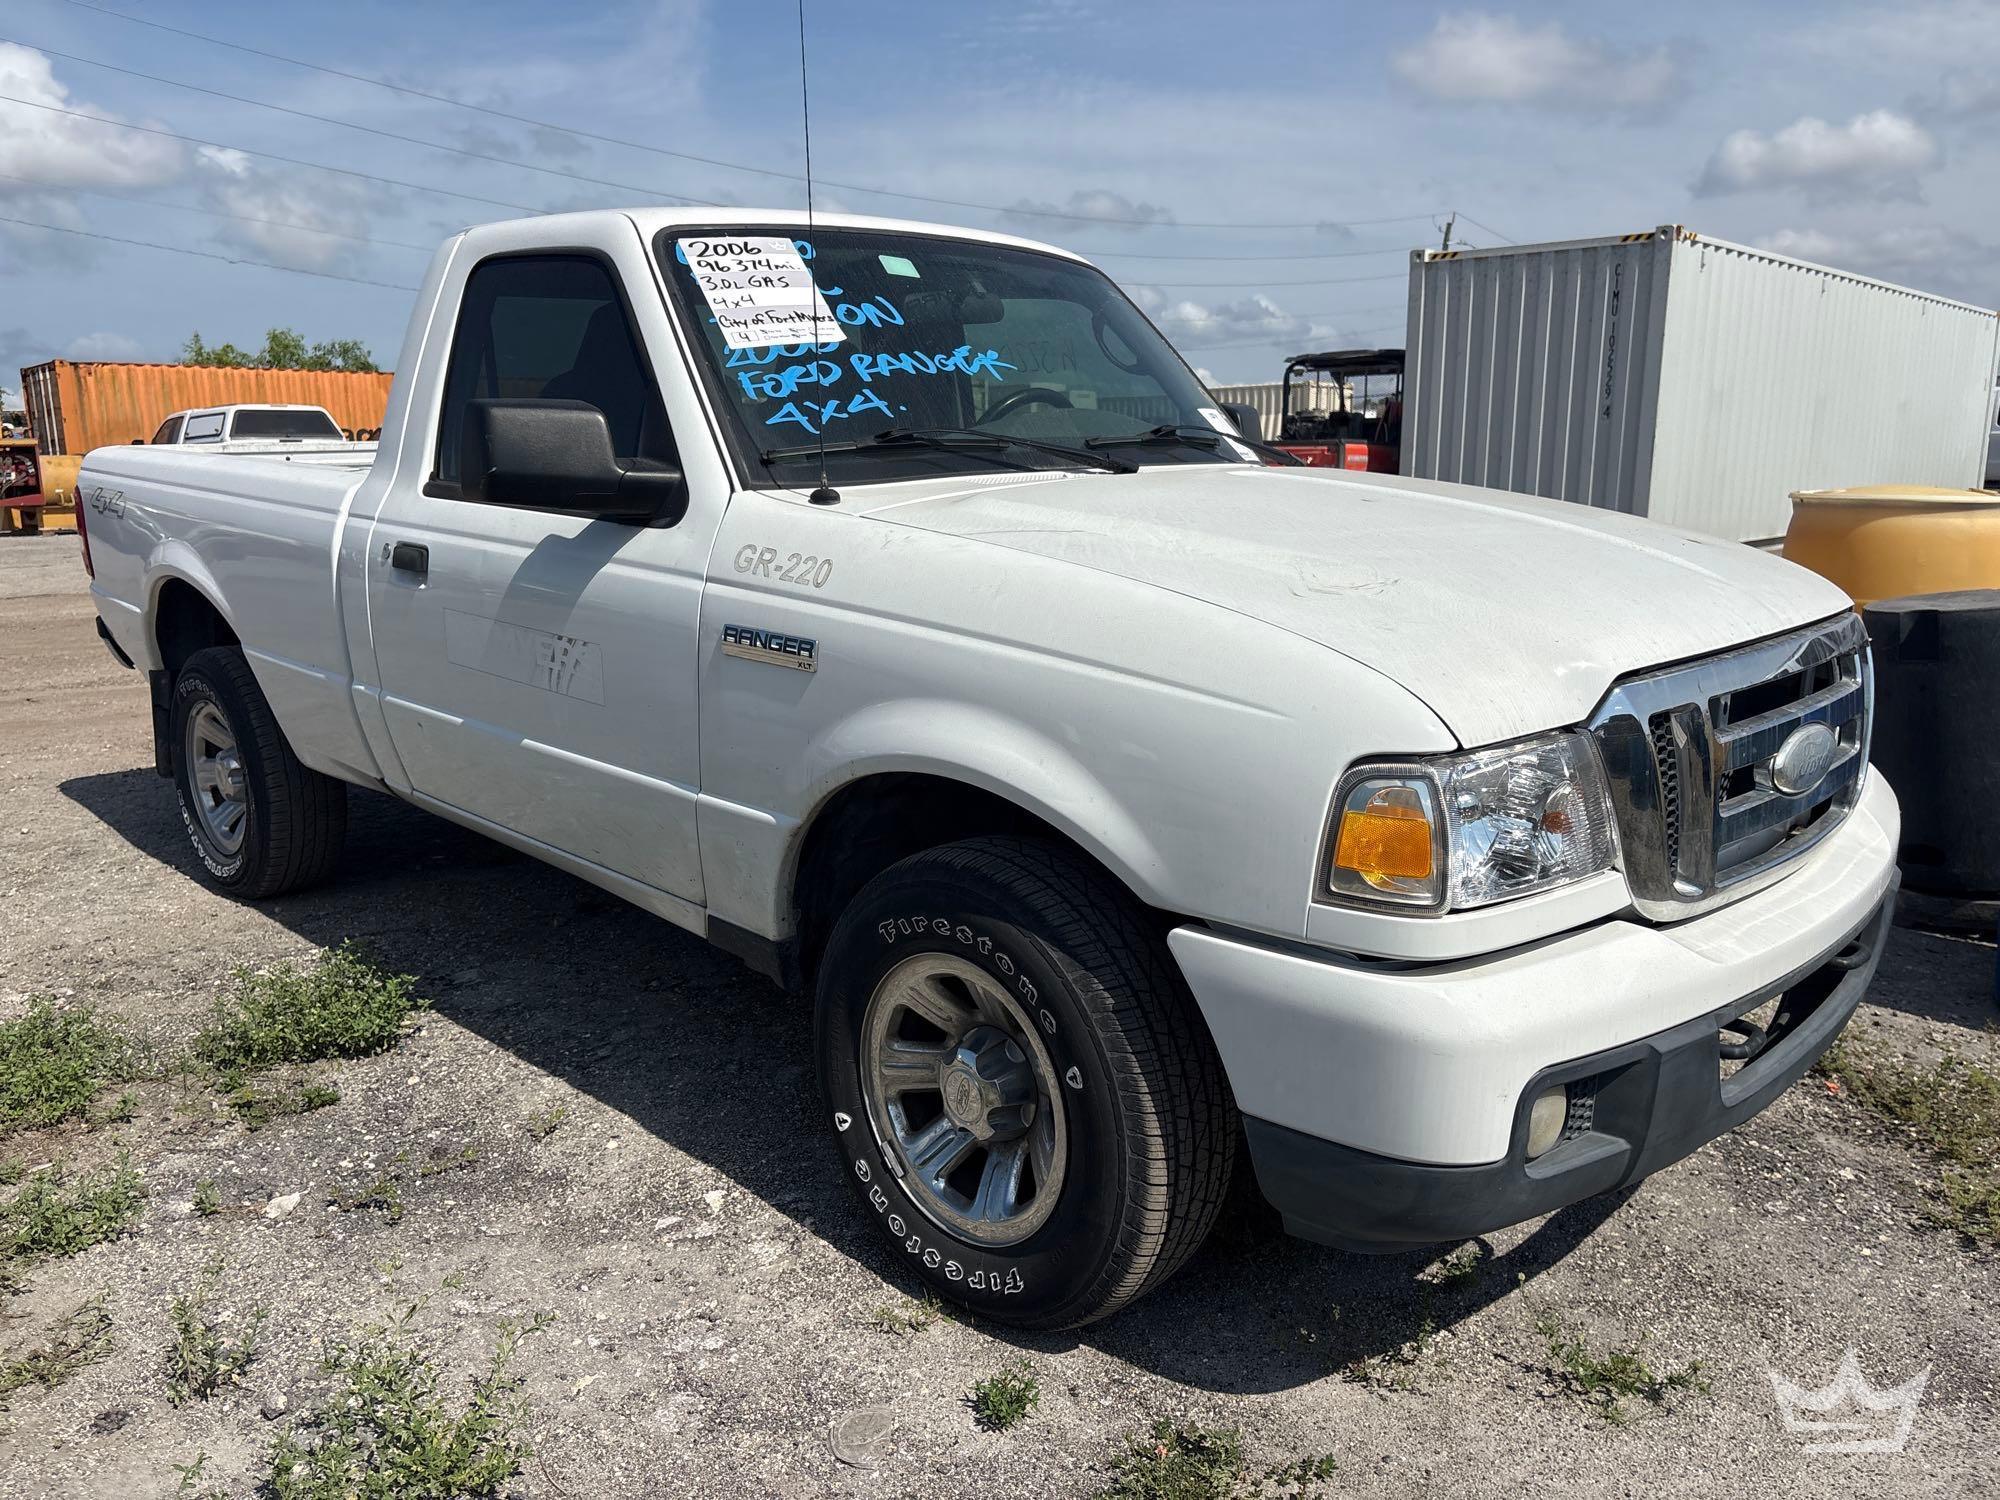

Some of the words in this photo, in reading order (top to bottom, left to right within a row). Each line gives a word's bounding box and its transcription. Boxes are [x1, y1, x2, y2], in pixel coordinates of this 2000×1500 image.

[688, 241, 762, 258] 2006
[748, 275, 790, 288] GAS
[718, 314, 749, 329] City
[752, 313, 765, 325] of
[765, 310, 796, 324] Fort
[738, 360, 842, 400] FORD
[850, 345, 1017, 382] RANGER
[733, 544, 833, 589] GR-220
[722, 625, 815, 659] RANGER
[796, 660, 813, 671] XLT
[878, 915, 1057, 1035] Firestone
[854, 1158, 1025, 1296] Firestone
